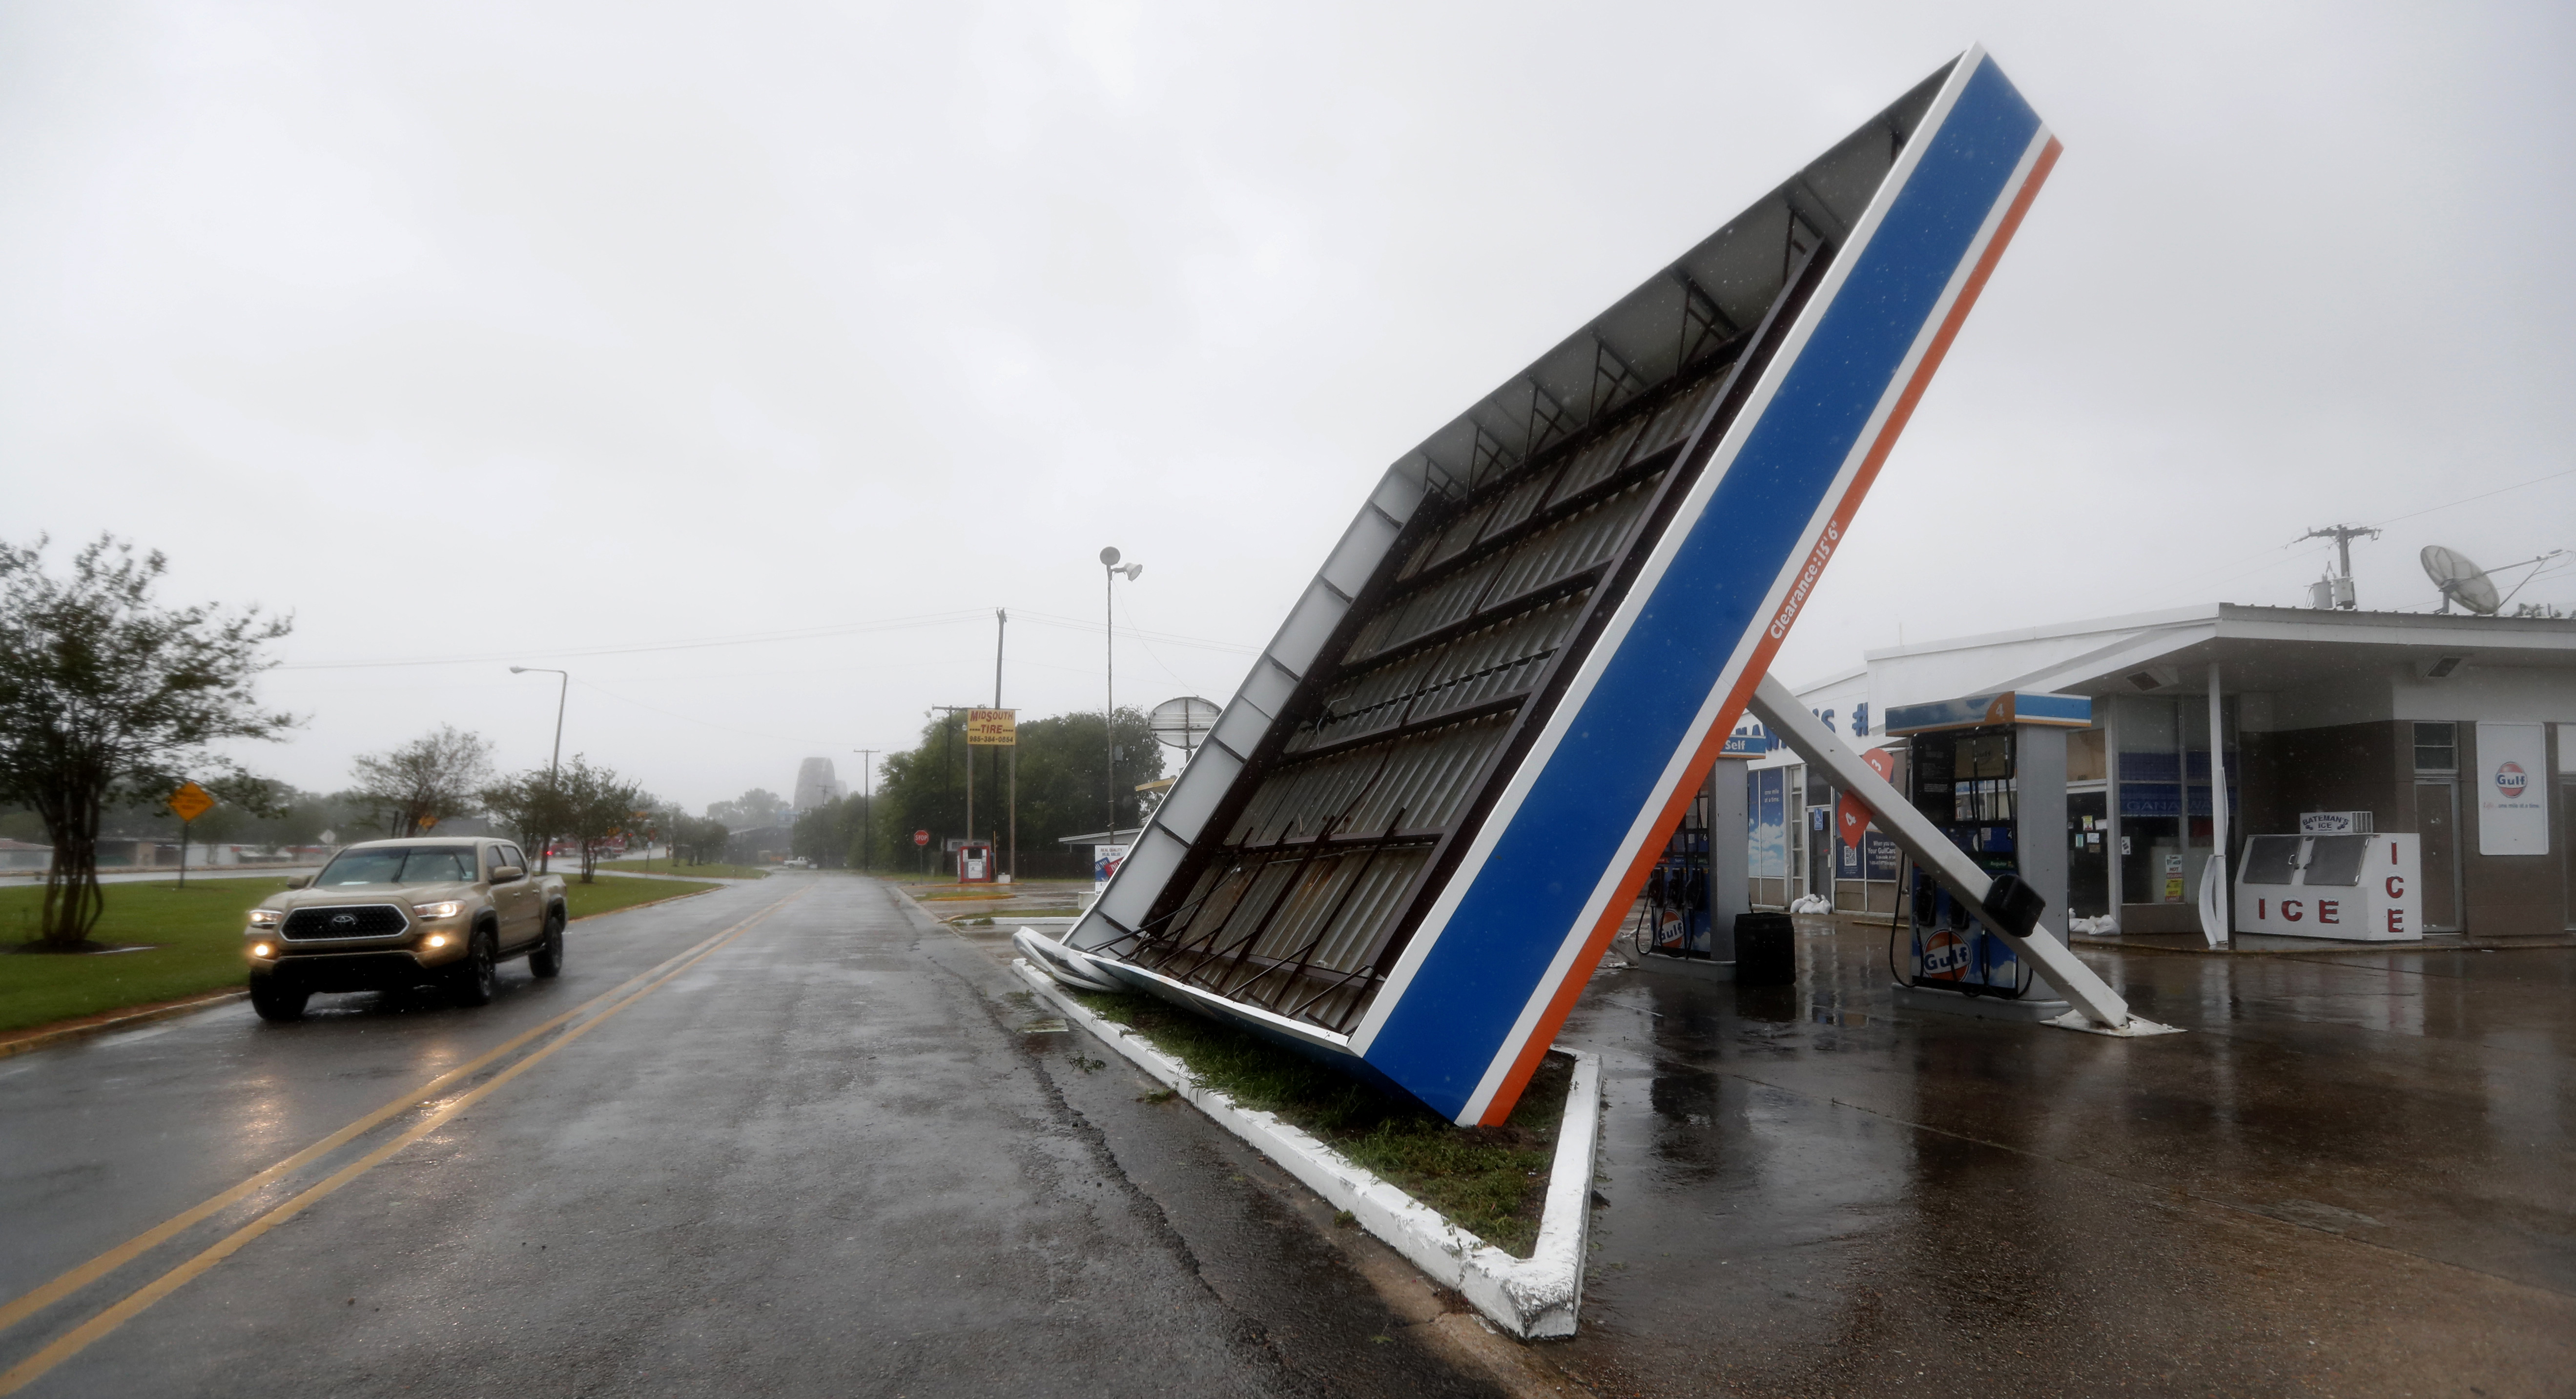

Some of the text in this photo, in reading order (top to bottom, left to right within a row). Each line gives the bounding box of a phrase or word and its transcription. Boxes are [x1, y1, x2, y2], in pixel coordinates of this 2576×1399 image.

[969, 710, 1013, 722] MIDSOUTH
[1996, 703, 2004, 718] 4
[980, 724, 1003, 734] TIRE
[1725, 740, 1746, 750] Self
[1871, 759, 1882, 772] 3
[2496, 774, 2525, 785] Gulf
[1845, 812, 1856, 826] 4
[2302, 815, 2349, 825] BATEMAN'S
[2385, 840, 2405, 933] ICE
[2258, 895, 2340, 924] ICE
[1658, 922, 1684, 941] Gulf
[1923, 946, 1968, 971] Gulf
